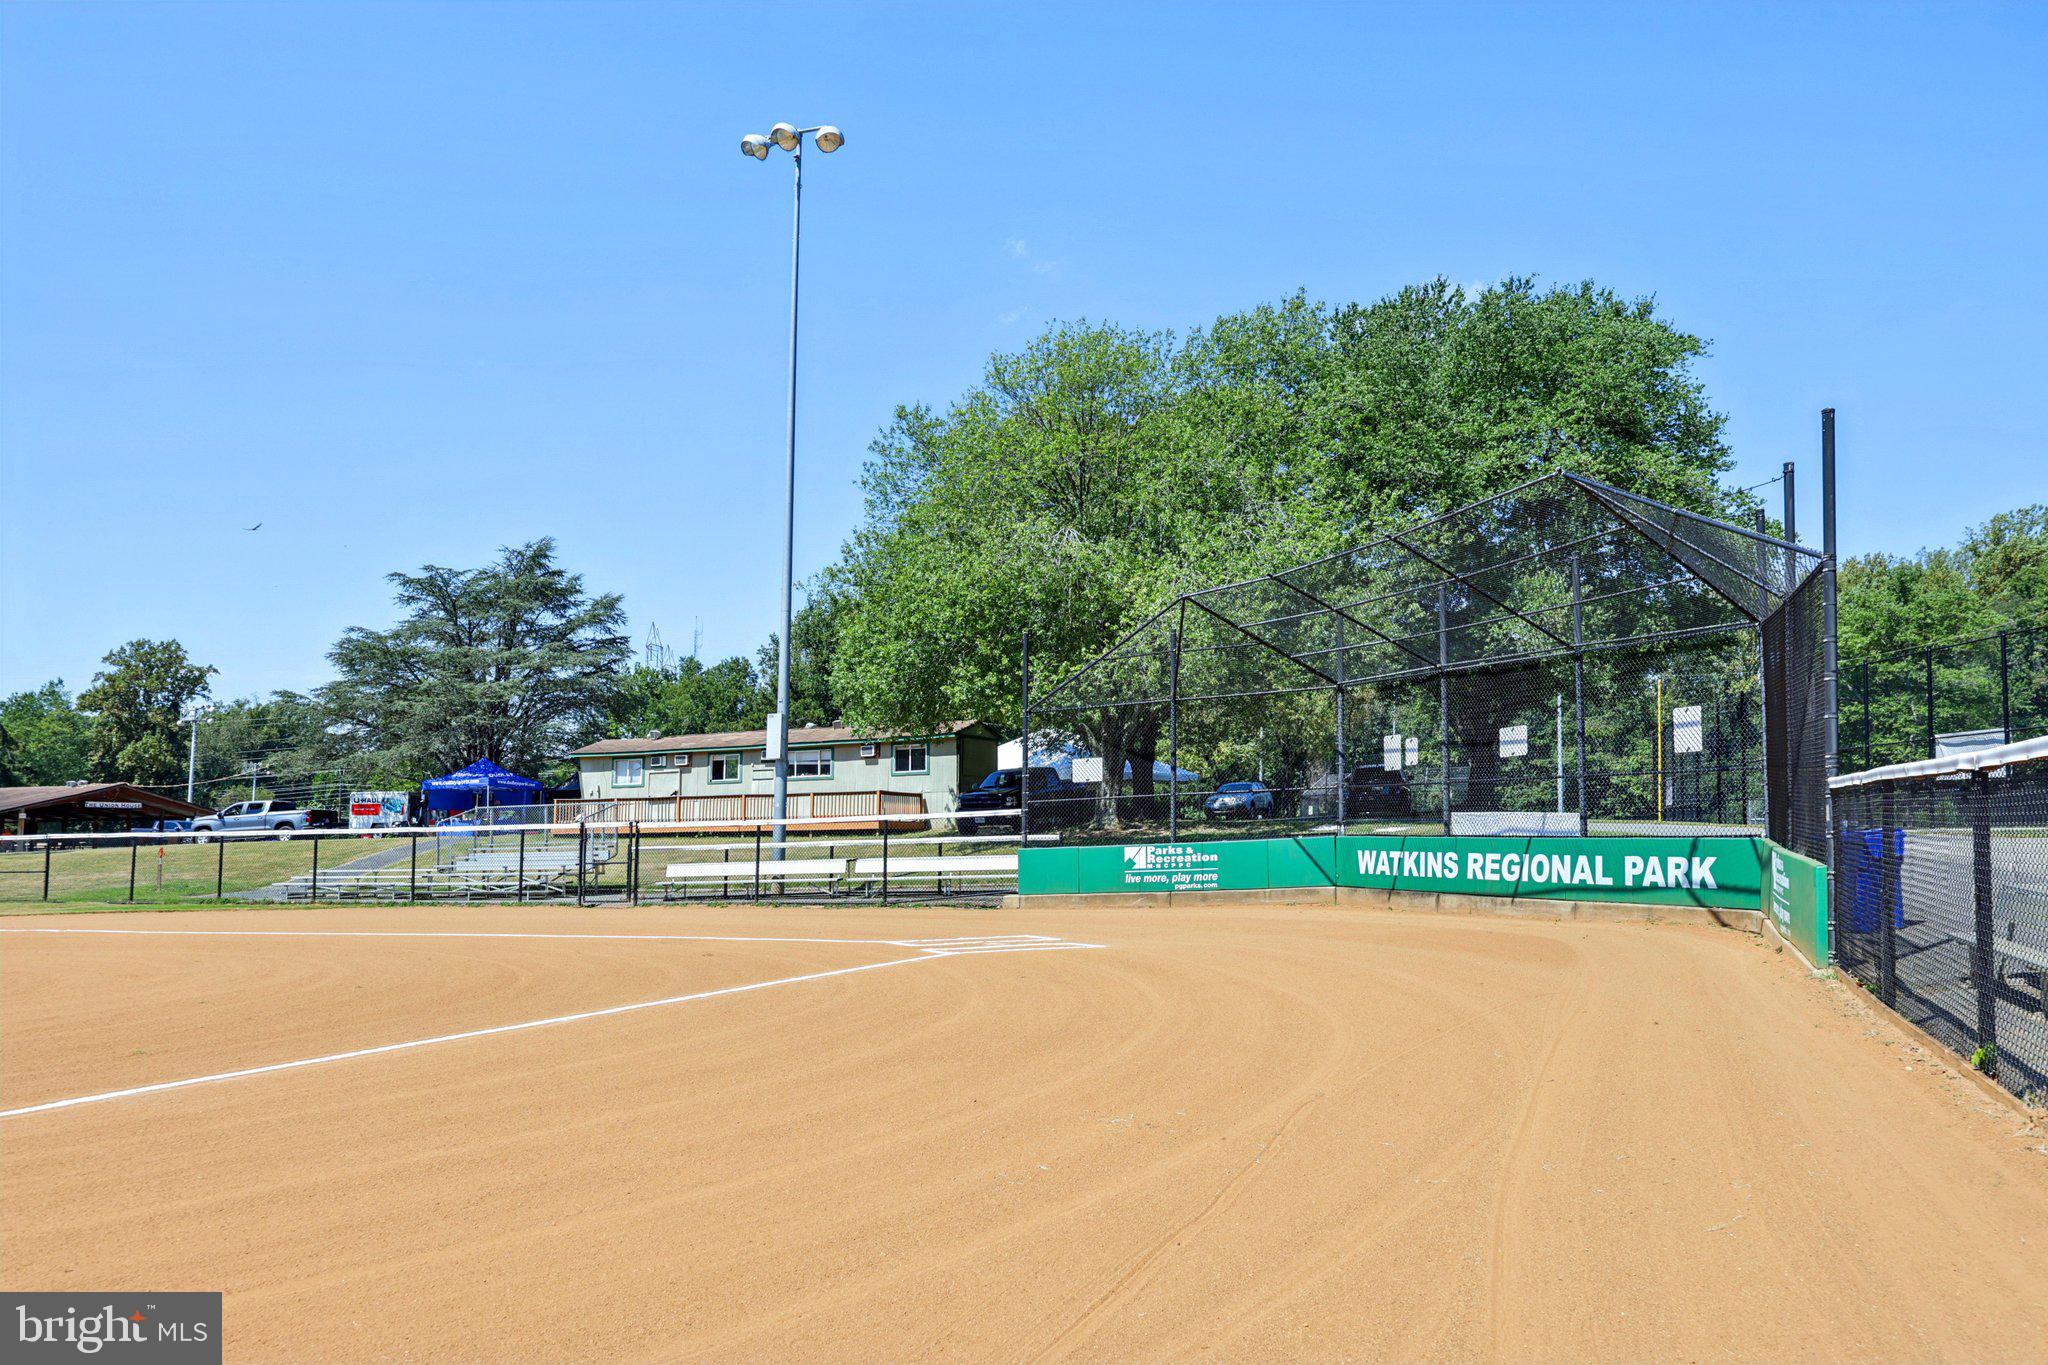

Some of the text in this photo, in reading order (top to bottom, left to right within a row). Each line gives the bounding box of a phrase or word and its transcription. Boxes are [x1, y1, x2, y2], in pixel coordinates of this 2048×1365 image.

[1146, 846, 1195, 855] Parks &
[1146, 853, 1218, 863] Recreation
[1357, 849, 1719, 890] WATKINS REGIONAL PARK
[1125, 873, 1218, 884] live more, play more
